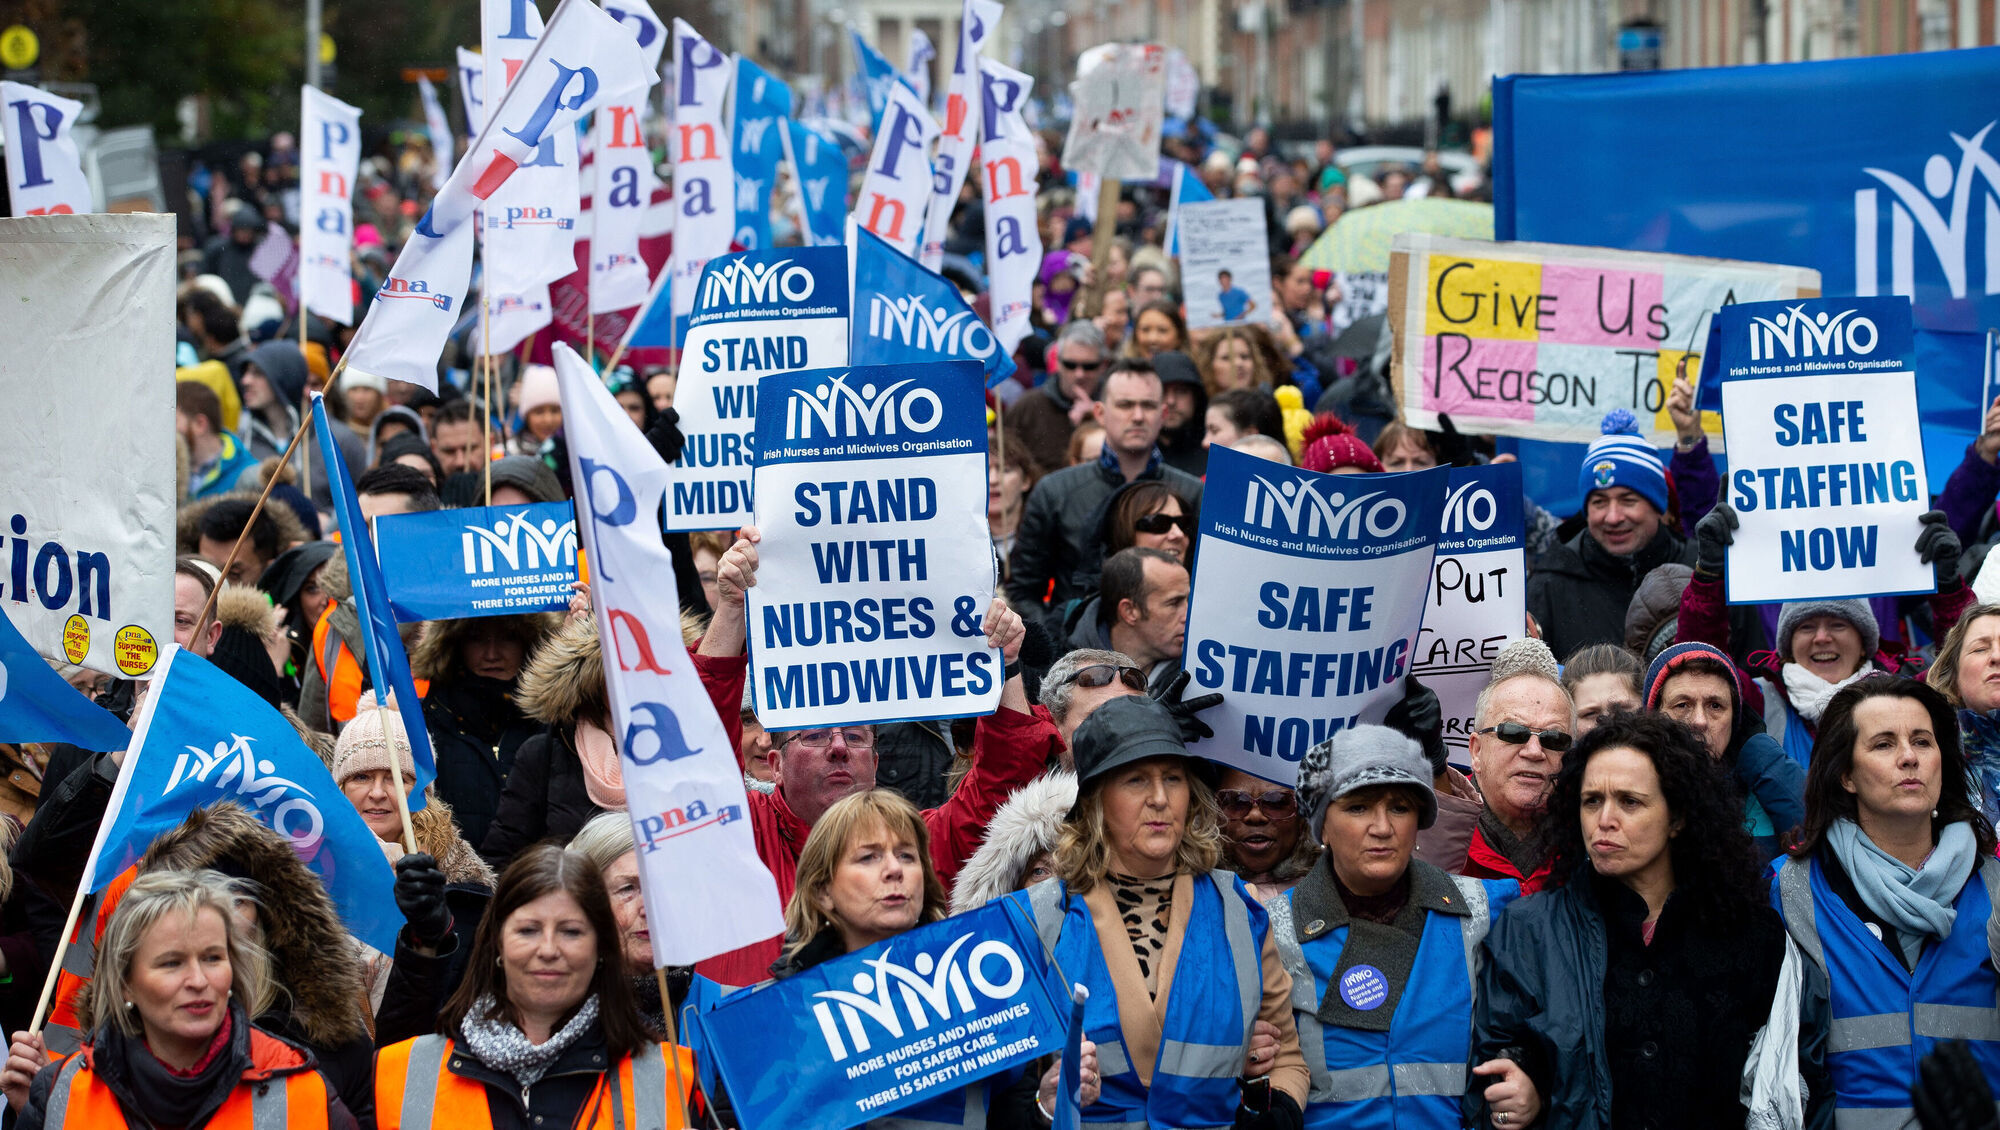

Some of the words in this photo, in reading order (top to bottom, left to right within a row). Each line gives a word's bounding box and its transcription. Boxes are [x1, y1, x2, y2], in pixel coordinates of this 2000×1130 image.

[505, 207, 553, 230] pna
[702, 255, 815, 309] INMO
[700, 311, 723, 322] Nurses
[724, 309, 739, 319] and
[741, 308, 780, 318] Midwives
[781, 306, 838, 317] Organisation
[869, 292, 997, 359] INMO
[1749, 302, 1878, 360] INMO
[702, 335, 809, 373] STAND
[1729, 367, 1749, 377] Irish
[1750, 364, 1782, 375] Nurses
[1784, 363, 1801, 373] and
[1804, 360, 1846, 372] Midwives
[1847, 359, 1903, 371] Organisation
[712, 385, 759, 419] WI
[785, 371, 943, 440] INMO
[1773, 400, 1867, 447] SAFE
[675, 431, 755, 468] NURS
[763, 450, 782, 460] Irish
[783, 446, 820, 458] Nurses
[823, 445, 844, 456] and
[847, 442, 899, 454] Midwives
[902, 438, 973, 453] Organisation
[794, 476, 938, 528] STAND
[1243, 473, 1407, 540] INMO
[1733, 460, 1919, 513] STAFFING
[462, 509, 577, 574] INM
[1214, 521, 1238, 537] Irish
[1240, 529, 1280, 548] Nurses
[1281, 539, 1303, 552] and
[1306, 543, 1359, 556] Midwives
[1362, 534, 1427, 555] Organisation
[1437, 540, 1465, 549] wives
[1467, 534, 1516, 548] Organisation
[1780, 525, 1878, 572] NOW
[0, 514, 111, 621] ion
[471, 578, 501, 588] MORE
[502, 575, 540, 586] NURSES
[542, 573, 564, 583] AND
[810, 538, 928, 584] WITH
[471, 598, 503, 609] THERE
[505, 598, 514, 608] IS
[515, 595, 552, 607] SAFETY
[554, 594, 564, 604] IN
[504, 587, 526, 596] FOR
[526, 584, 557, 595] SAFER
[1257, 581, 1375, 633] SAFE
[66, 631, 88, 643] SUPPORT
[762, 596, 936, 649] NURSES
[951, 595, 987, 638] &
[73, 641, 82, 650] THE
[117, 641, 152, 653] SUPPORT
[119, 660, 148, 670] NURSES
[126, 651, 141, 660] THE
[763, 651, 994, 711] MIDWIVES
[1195, 637, 1409, 698] STAFFING
[634, 799, 712, 855] pna
[812, 931, 1025, 1062] INMO
[1345, 969, 1372, 987] INMO
[1348, 983, 1366, 996] Stand
[1366, 977, 1380, 988] with
[1350, 989, 1372, 1002] Nurses
[1372, 983, 1384, 993] and
[1355, 991, 1385, 1007] Midwives
[846, 1056, 886, 1080] MORE
[886, 1037, 937, 1064] NURSES
[938, 1026, 966, 1046] AND
[966, 1002, 1030, 1035] MIDWIVES
[894, 1061, 923, 1080] FOR
[922, 1044, 964, 1069] SAFER
[964, 1032, 998, 1053] CARE
[856, 1087, 900, 1113] THERE
[899, 1081, 913, 1097] IS
[915, 1063, 960, 1092] SAFETY
[961, 1057, 978, 1074] IN
[976, 1035, 1040, 1068] NUMBERS
